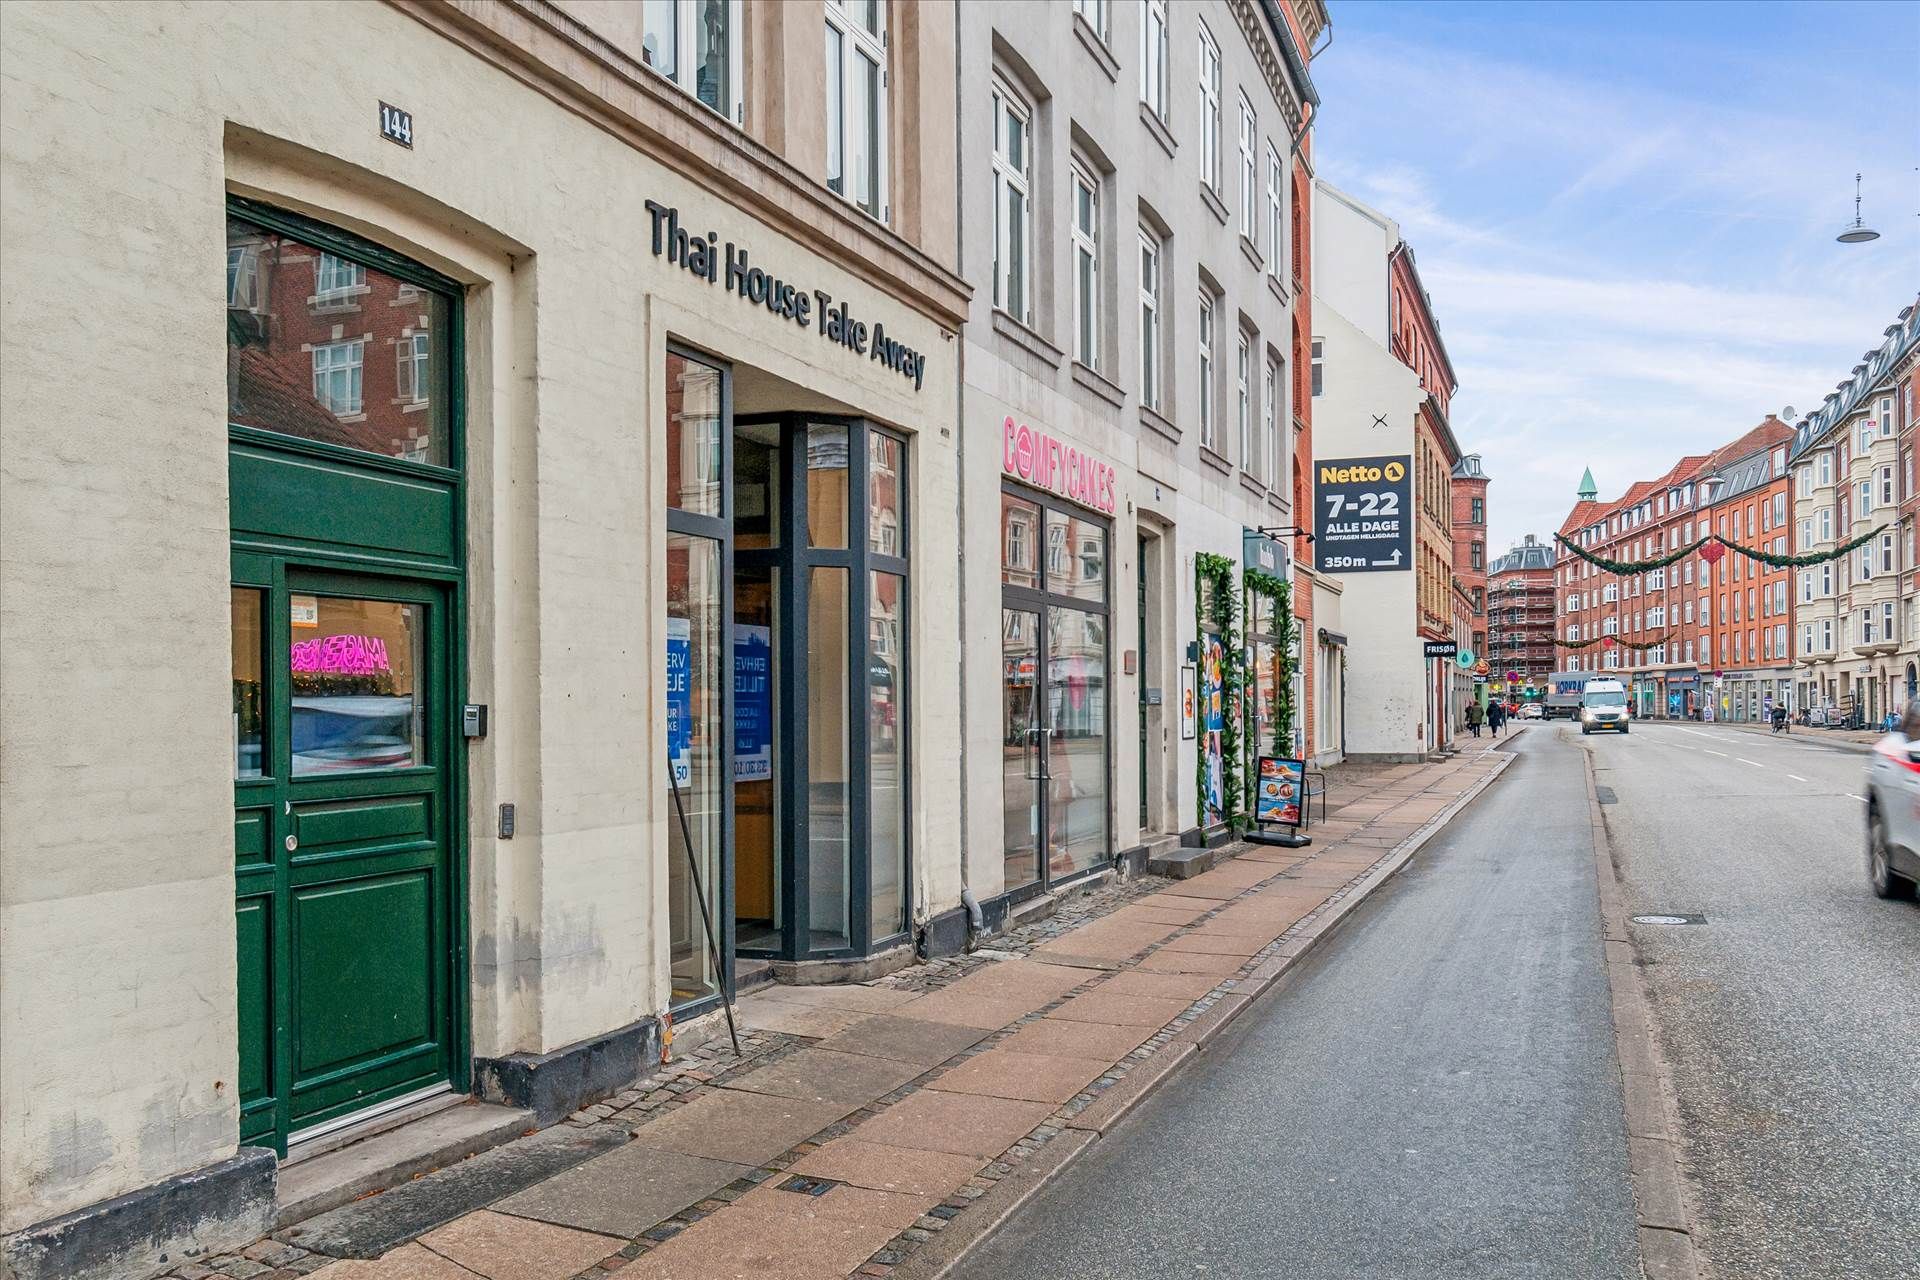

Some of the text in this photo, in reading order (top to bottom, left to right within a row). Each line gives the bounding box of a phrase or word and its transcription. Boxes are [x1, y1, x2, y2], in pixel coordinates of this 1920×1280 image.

[383, 107, 411, 144] 144
[645, 199, 926, 392] Thai House Take Away
[1321, 466, 1381, 484] Netto
[1326, 492, 1399, 518] 7-22
[1326, 520, 1400, 534] ALLE DAGE
[1360, 532, 1400, 540] HELLIGDAGE
[1426, 645, 1456, 653] FRISØR
[676, 765, 688, 780] 50
